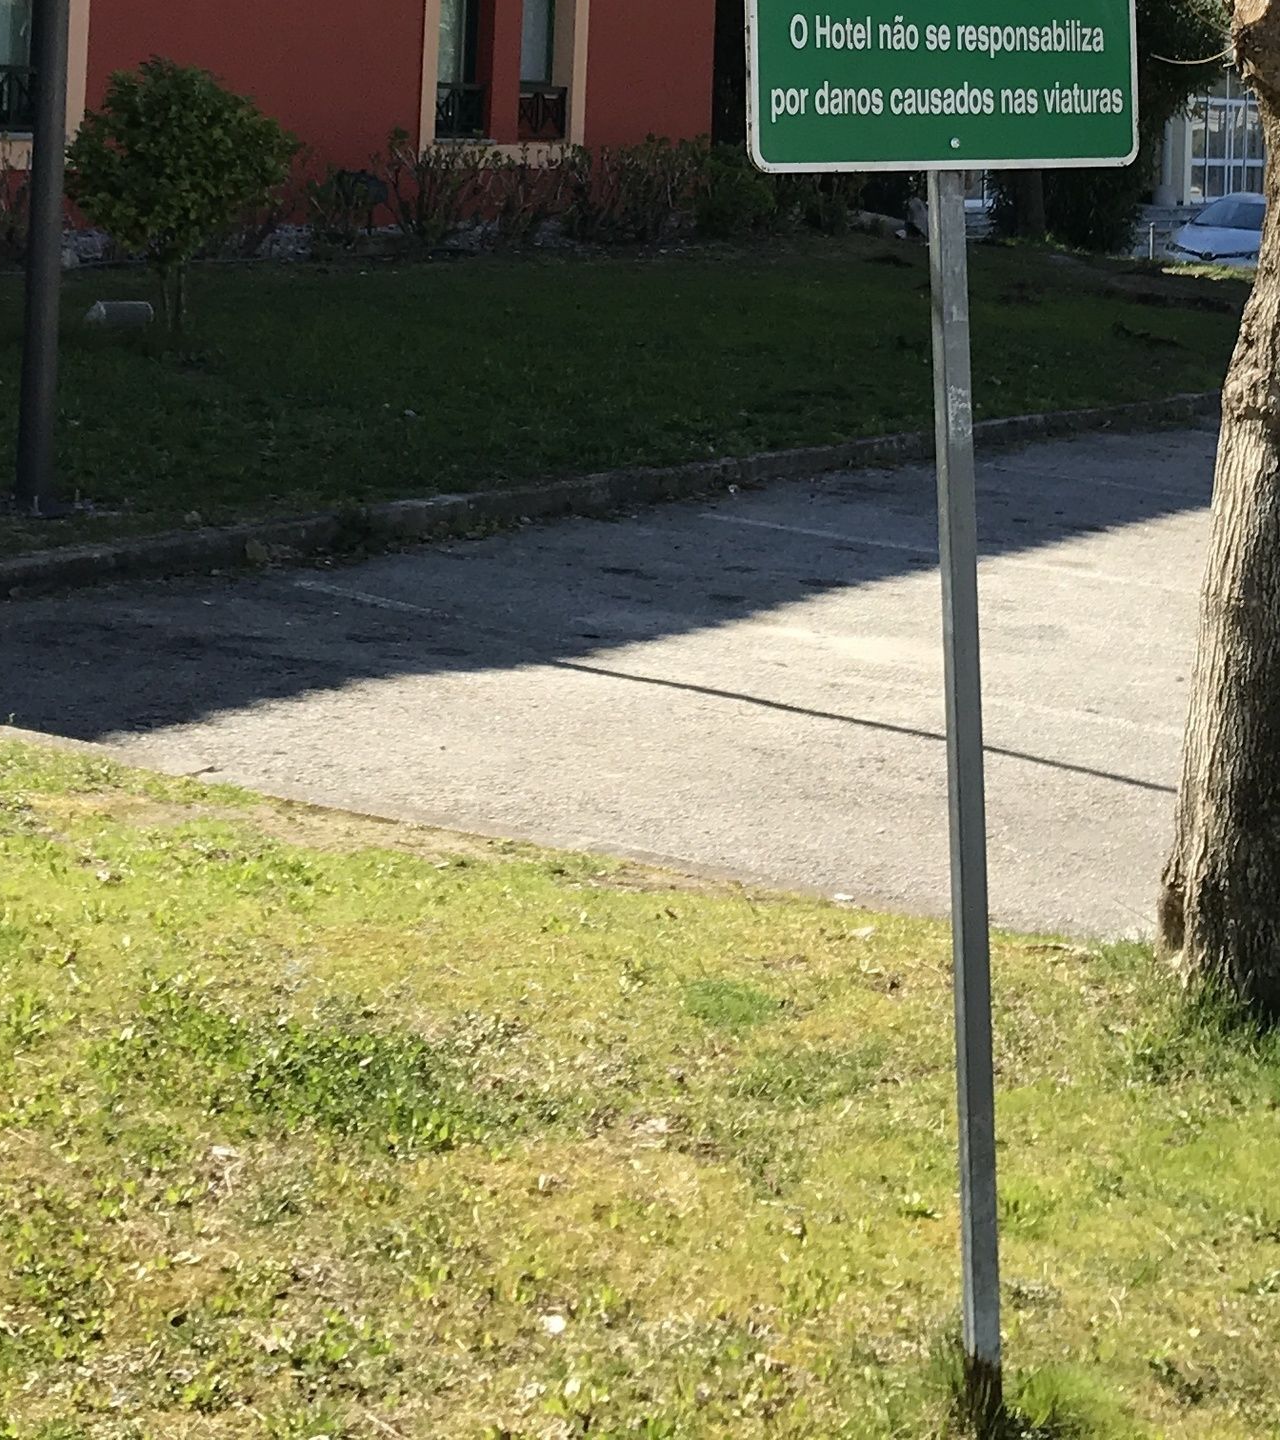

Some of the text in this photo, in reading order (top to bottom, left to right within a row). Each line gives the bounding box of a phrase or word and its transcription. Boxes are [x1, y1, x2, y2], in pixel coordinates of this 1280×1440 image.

[789, 13, 1105, 59] O Hotel não se responsabiliza
[770, 80, 1124, 124] por danos causados nas viaturas
